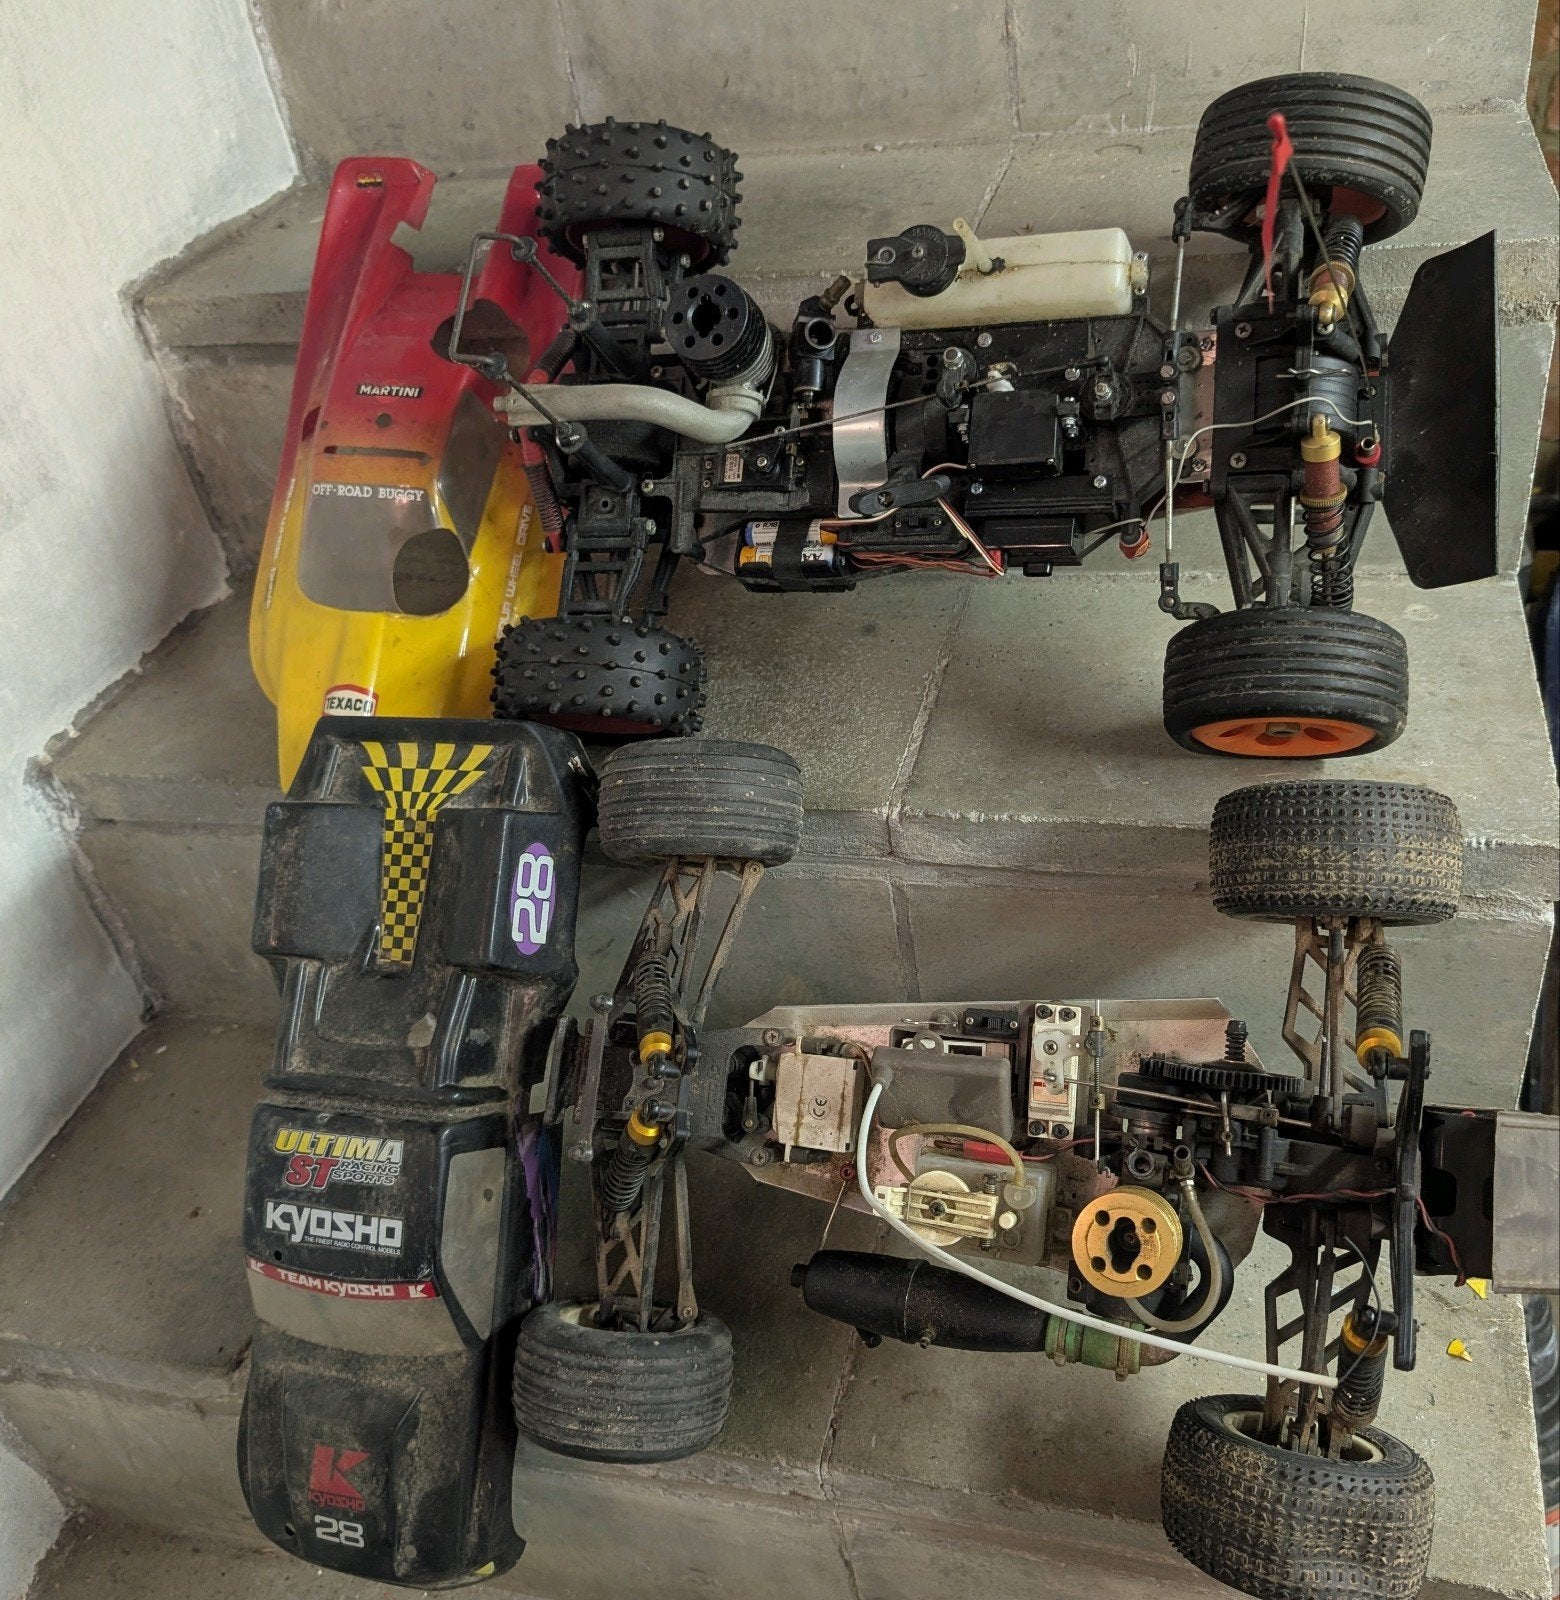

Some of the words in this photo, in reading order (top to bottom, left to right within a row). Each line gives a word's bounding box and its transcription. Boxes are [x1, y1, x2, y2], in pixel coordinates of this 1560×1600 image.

[359, 384, 420, 398] MARTINI
[312, 484, 373, 498] OFF-ROAD
[378, 487, 425, 502] BUGGY
[505, 551, 523, 598] WHEEL
[516, 504, 533, 546] DRIVE
[326, 696, 374, 714] TEXACO
[511, 853, 555, 945] 28
[273, 1128, 405, 1166] ULTIMA
[284, 1153, 341, 1190] ST
[331, 1170, 398, 1187] SPORTS
[340, 1161, 402, 1176] RACING
[304, 1235, 315, 1243] THE
[315, 1236, 333, 1246] FINEST
[333, 1240, 351, 1248] RADIO
[351, 1242, 377, 1252] CONTROL
[377, 1246, 401, 1255] MODELS
[277, 1268, 322, 1290] TEAM
[314, 1514, 365, 1548] 28
